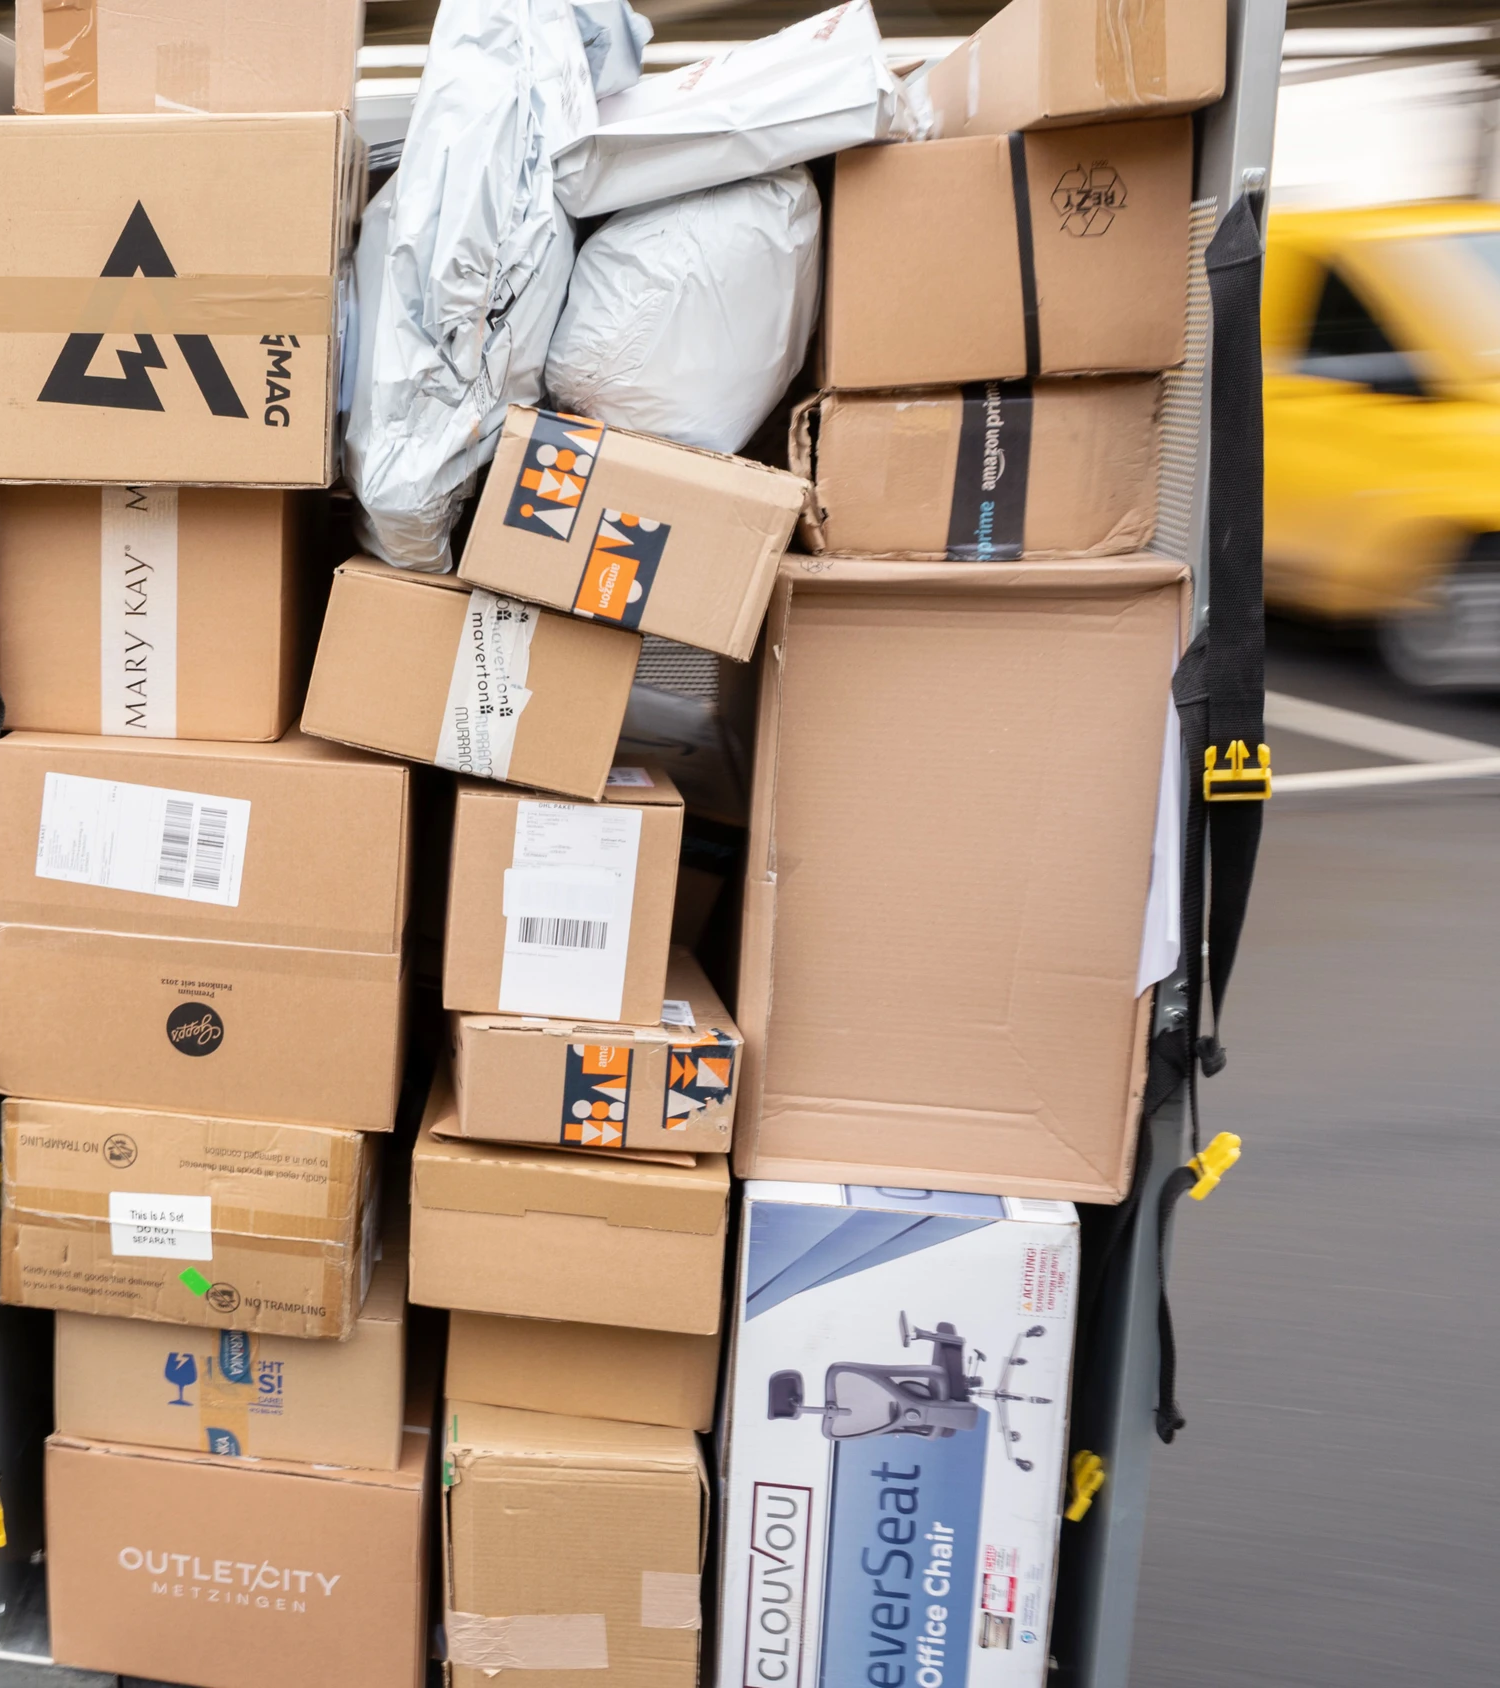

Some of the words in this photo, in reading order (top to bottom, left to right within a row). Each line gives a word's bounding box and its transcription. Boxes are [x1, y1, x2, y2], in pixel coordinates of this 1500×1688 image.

[981, 428, 1001, 491] amazon
[973, 500, 996, 555] prime
[598, 562, 621, 609] amazon
[472, 612, 491, 703] maverton
[124, 631, 155, 729] MARY
[161, 978, 179, 986] 2012
[181, 979, 196, 987] seit
[198, 981, 233, 991] Feinkost
[178, 988, 215, 998] Premium
[20, 1134, 80, 1152] TRAMPLING
[83, 1142, 99, 1153] NO
[243, 1151, 283, 1163] damaged
[292, 1157, 301, 1165] in
[303, 1157, 318, 1167] you
[320, 1159, 328, 1168] to
[179, 1159, 218, 1172] delivered
[219, 1164, 235, 1174] that
[236, 1166, 264, 1177] goods
[264, 1169, 274, 1178] all
[276, 1171, 300, 1181] reject
[301, 1171, 328, 1184] Kindly
[130, 1209, 147, 1221] This
[150, 1210, 158, 1221] Is
[160, 1211, 167, 1221] A
[169, 1211, 184, 1223] Set
[136, 1225, 152, 1233] DO
[154, 1226, 175, 1235] NOT
[23, 1265, 48, 1276] Kindly
[84, 1273, 109, 1283] goods
[1023, 1247, 1037, 1299] ACHTUNG!
[33, 1281, 50, 1290] you
[66, 1284, 103, 1296] damaged
[244, 1297, 262, 1307] NO
[264, 1299, 327, 1317] TRAMPLING
[922, 1520, 956, 1597] Chair
[151, 1580, 307, 1614] METZINGEN
[915, 1603, 949, 1688] Office
